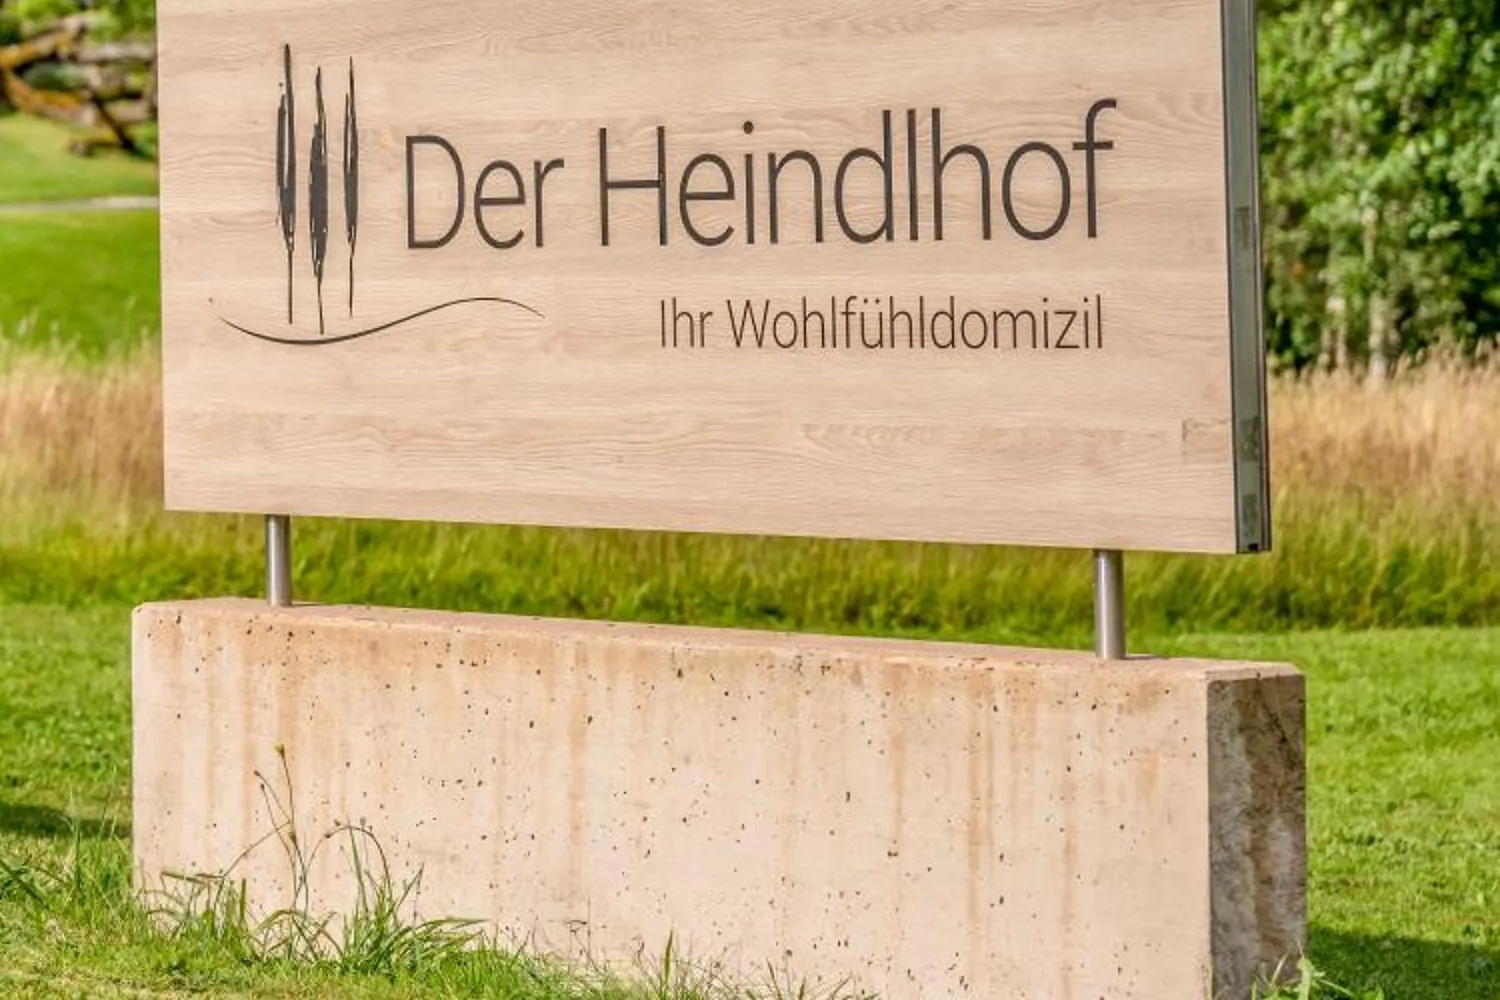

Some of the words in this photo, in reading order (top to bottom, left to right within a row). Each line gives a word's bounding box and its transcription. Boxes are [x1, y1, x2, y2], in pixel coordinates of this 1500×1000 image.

[405, 134, 565, 250] Der
[599, 97, 1118, 248] Heindlhof
[660, 296, 714, 349] Ihr
[726, 293, 1104, 350] Wohlfühldomizil
